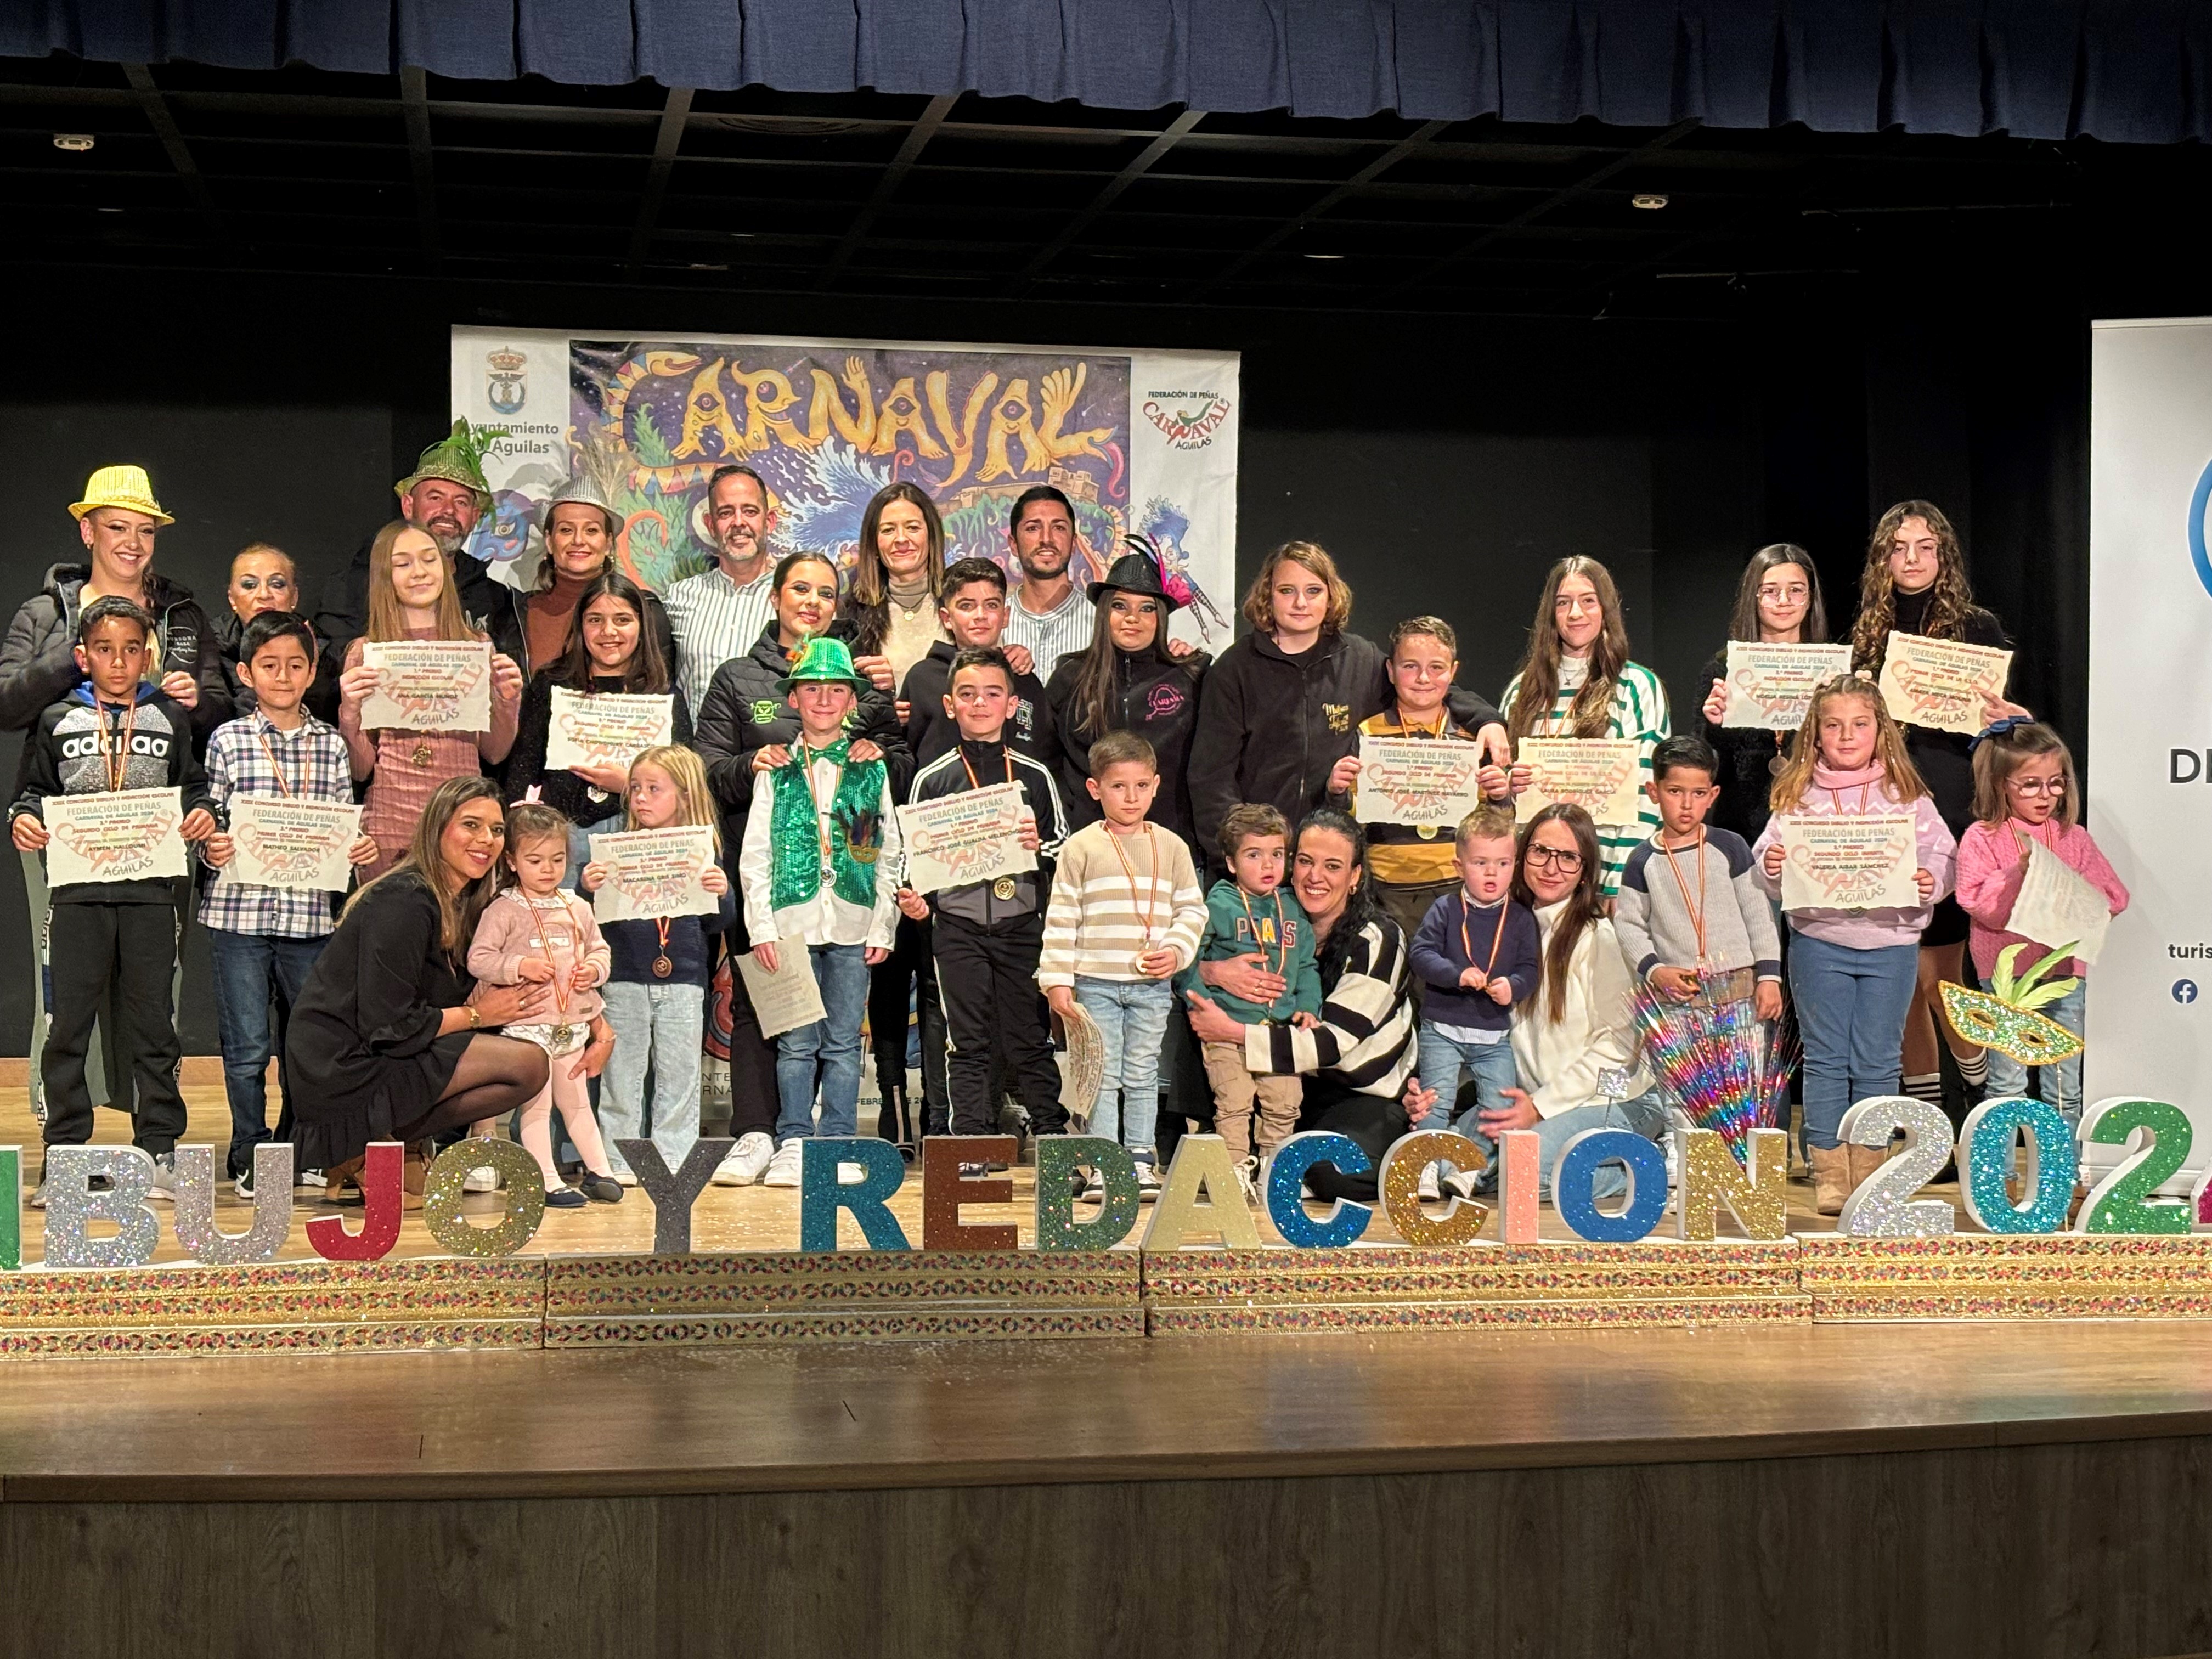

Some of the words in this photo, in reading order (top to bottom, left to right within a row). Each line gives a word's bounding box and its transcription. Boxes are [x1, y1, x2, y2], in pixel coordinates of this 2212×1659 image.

[1199, 390, 1218, 399] PEÑAS
[601, 350, 1118, 488] CARNAVAL
[1143, 401, 1231, 445] CARNAVAL
[470, 422, 558, 435] yuntamiento
[1748, 654, 1797, 663] FEDERACIÓN
[1808, 656, 1832, 664] PEÑAS
[1908, 647, 1953, 662] FEDERACIÓN
[1955, 654, 1965, 664] DE
[1966, 656, 1990, 668] PEÑAS
[1379, 749, 1425, 759] FEDERACIÓN
[1427, 751, 1436, 759] DE
[1438, 752, 1461, 760] PEÑAS
[66, 804, 119, 816] FEDERACIÓN
[122, 803, 133, 812] DE
[134, 801, 161, 811] PEÑAS
[253, 809, 301, 820] FEDERACIÓN
[304, 812, 313, 821] DE
[315, 813, 340, 823] PEÑAS
[919, 805, 966, 823] FEDERACIÓN
[968, 802, 978, 812] DE
[979, 797, 1003, 810] PEÑAS
[1403, 805, 1448, 820] AGUILAS
[1803, 828, 1853, 837] FEDERACIÓN
[1856, 828, 1866, 836] DE
[1869, 827, 1894, 836] PEÑAS
[611, 842, 657, 853] FEDERACIÓN
[659, 841, 669, 849] DE
[670, 839, 695, 848] PEÑAS
[103, 856, 153, 877] AGUILAS
[270, 867, 319, 882] AGUILAS
[1835, 884, 1886, 903] AGUILAS
[613, 1137, 732, 1254] Y
[801, 1127, 1787, 1254] REDACCION
[1836, 1095, 2212, 1239] 202
